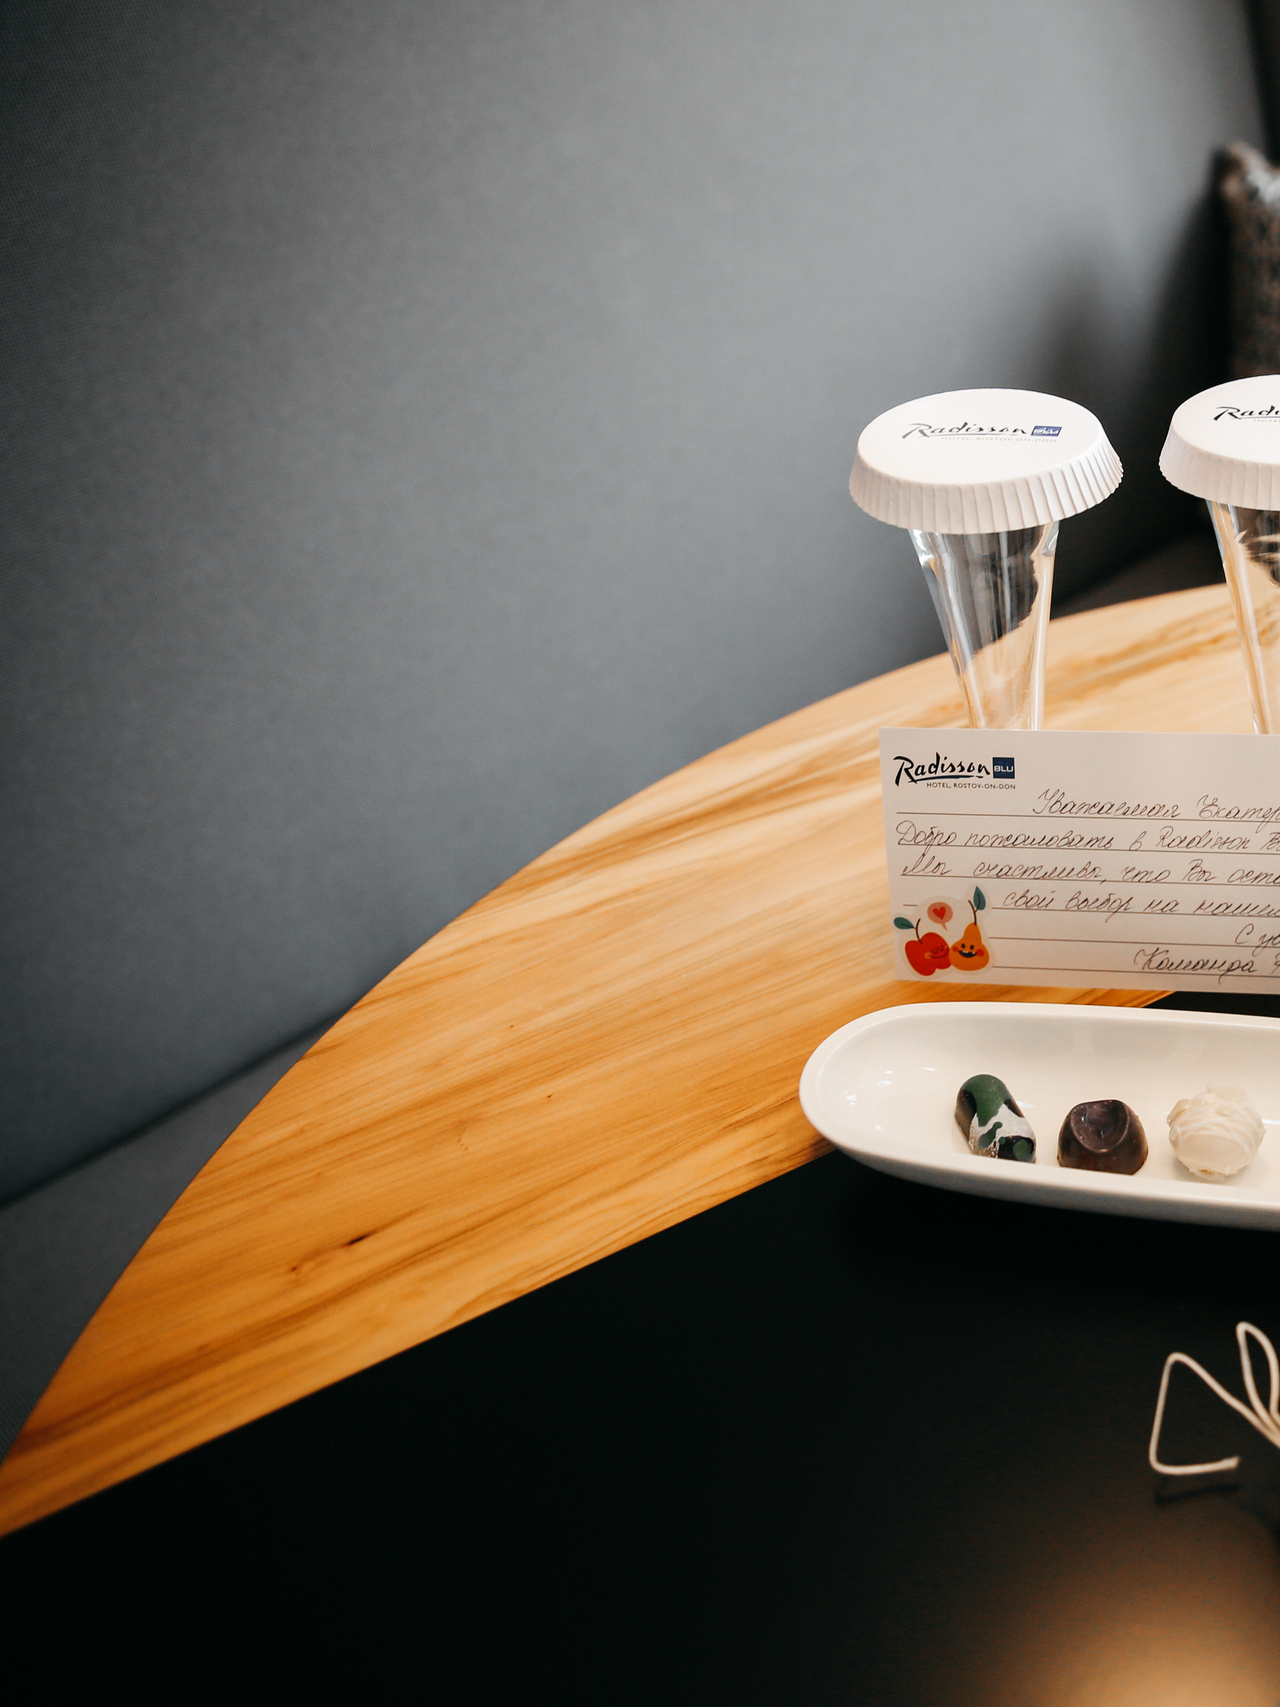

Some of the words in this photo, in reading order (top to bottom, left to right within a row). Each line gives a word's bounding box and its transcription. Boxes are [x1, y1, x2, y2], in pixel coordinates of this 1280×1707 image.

[902, 421, 1027, 439] Radisson
[893, 752, 990, 787] Radisson
[993, 764, 1014, 773] BLU
[1032, 788, 1181, 817] Уважаемая
[896, 820, 957, 857] Добро
[964, 829, 1114, 849] пожаловать
[1159, 826, 1250, 850] Radisson
[901, 852, 951, 875] Мы
[1121, 866, 1171, 883] что
[1181, 859, 1218, 882] Вы
[1003, 889, 1055, 909] свой
[1065, 890, 1134, 923] выбор
[1143, 899, 1181, 914] на
[1235, 923, 1255, 945] С
[1133, 946, 1259, 985] Команда
